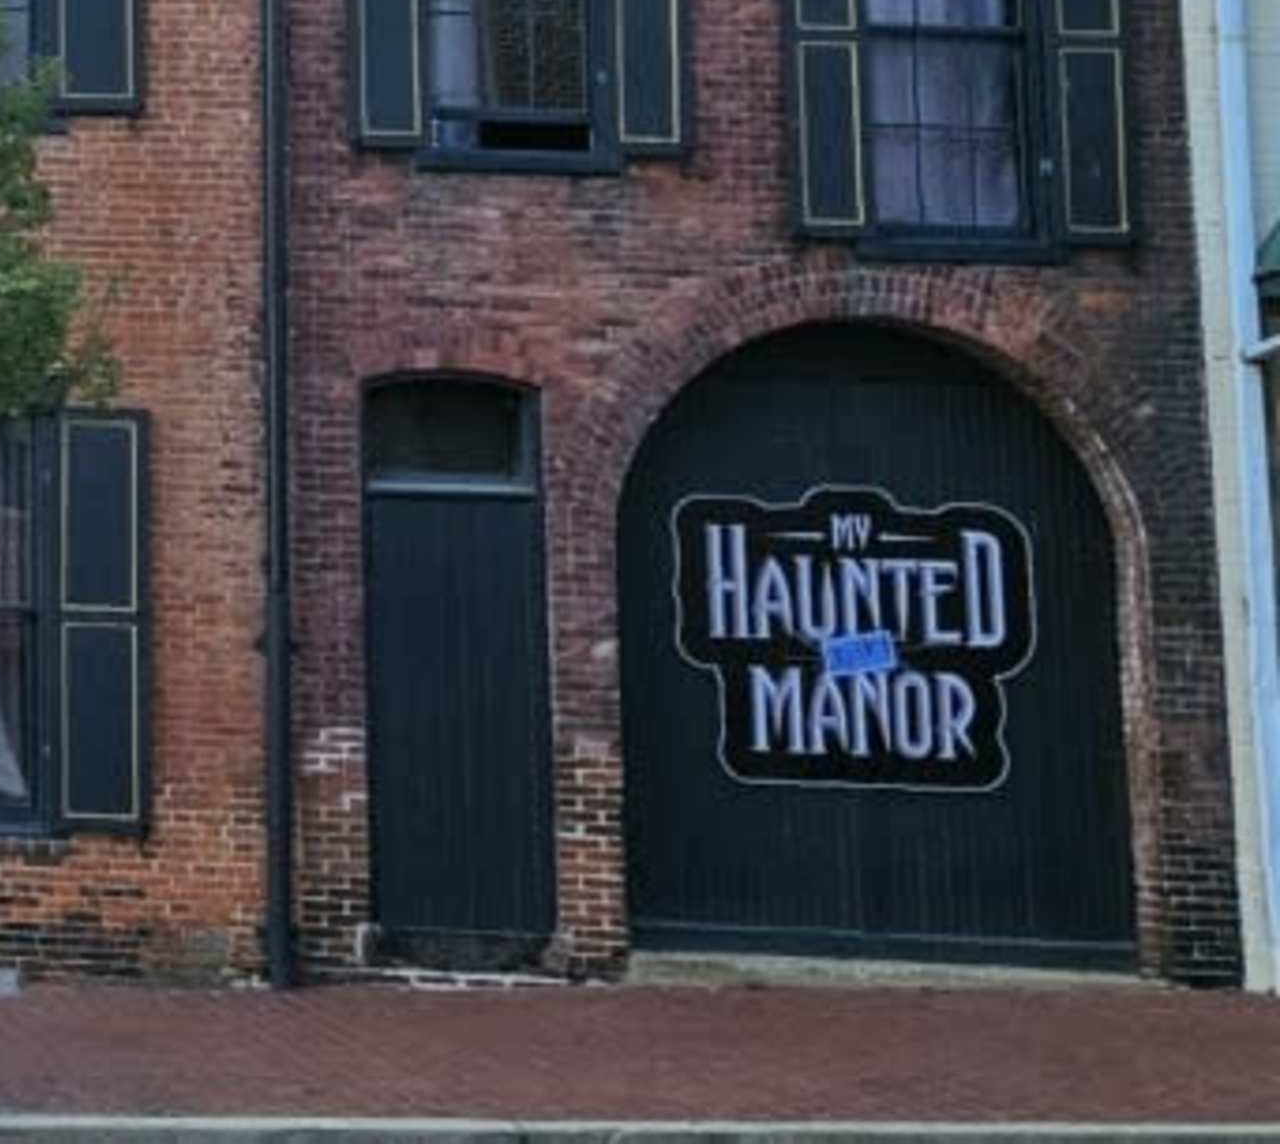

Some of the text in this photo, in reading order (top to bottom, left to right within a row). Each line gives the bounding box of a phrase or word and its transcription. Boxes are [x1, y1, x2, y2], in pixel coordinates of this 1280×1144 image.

[830, 514, 872, 550] MY
[706, 524, 1007, 646] HAUNTED
[750, 664, 976, 760] MANOR
